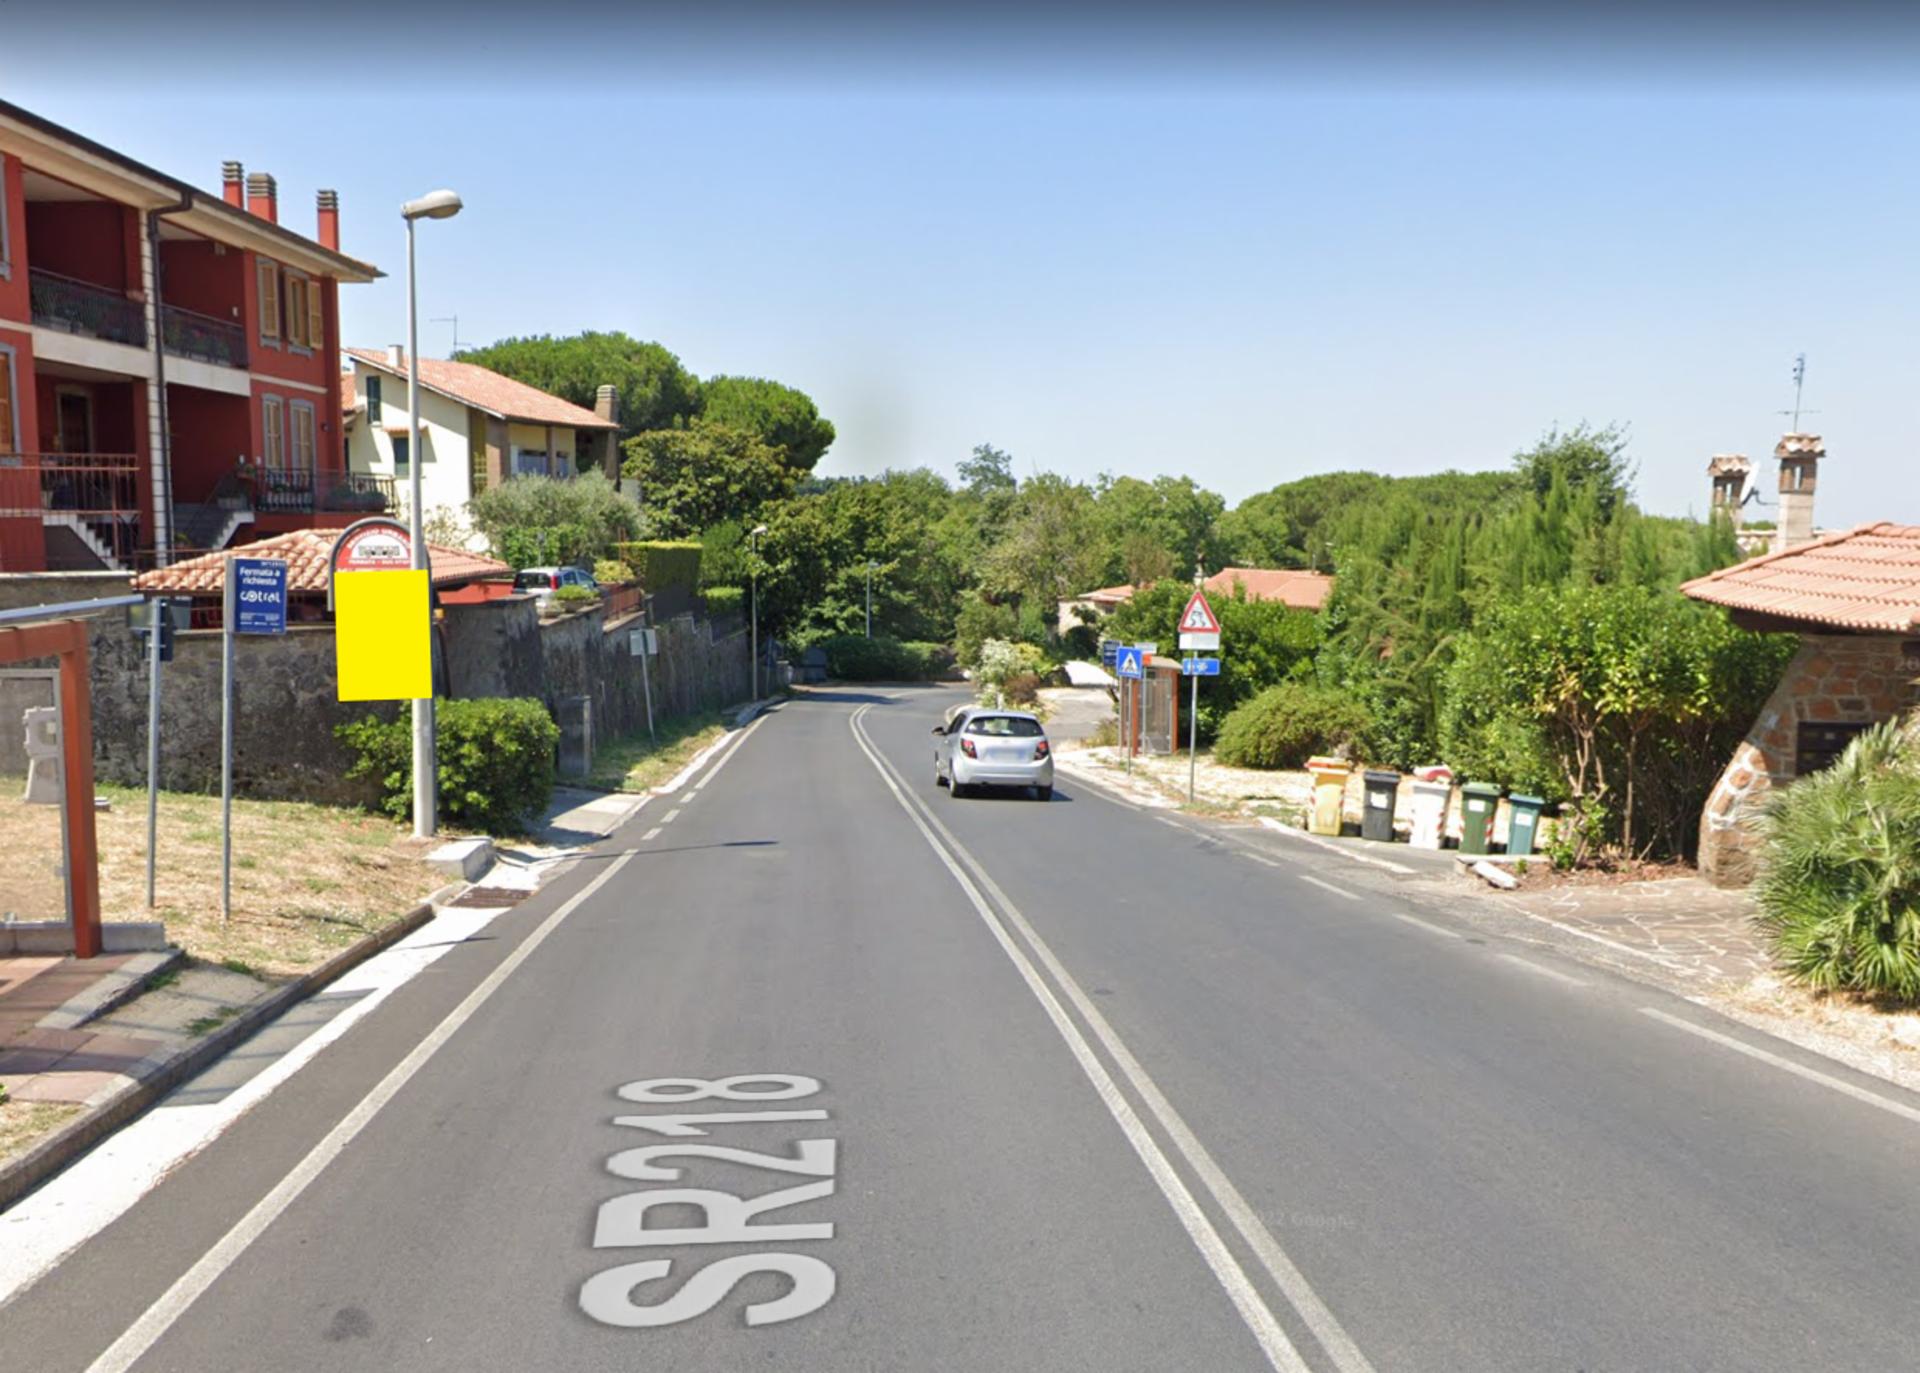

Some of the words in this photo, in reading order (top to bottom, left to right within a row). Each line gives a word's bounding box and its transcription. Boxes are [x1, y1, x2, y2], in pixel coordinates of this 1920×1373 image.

[239, 567, 273, 577] Fermata
[242, 577, 277, 586] richiesta
[579, 1074, 836, 1327] SR218
